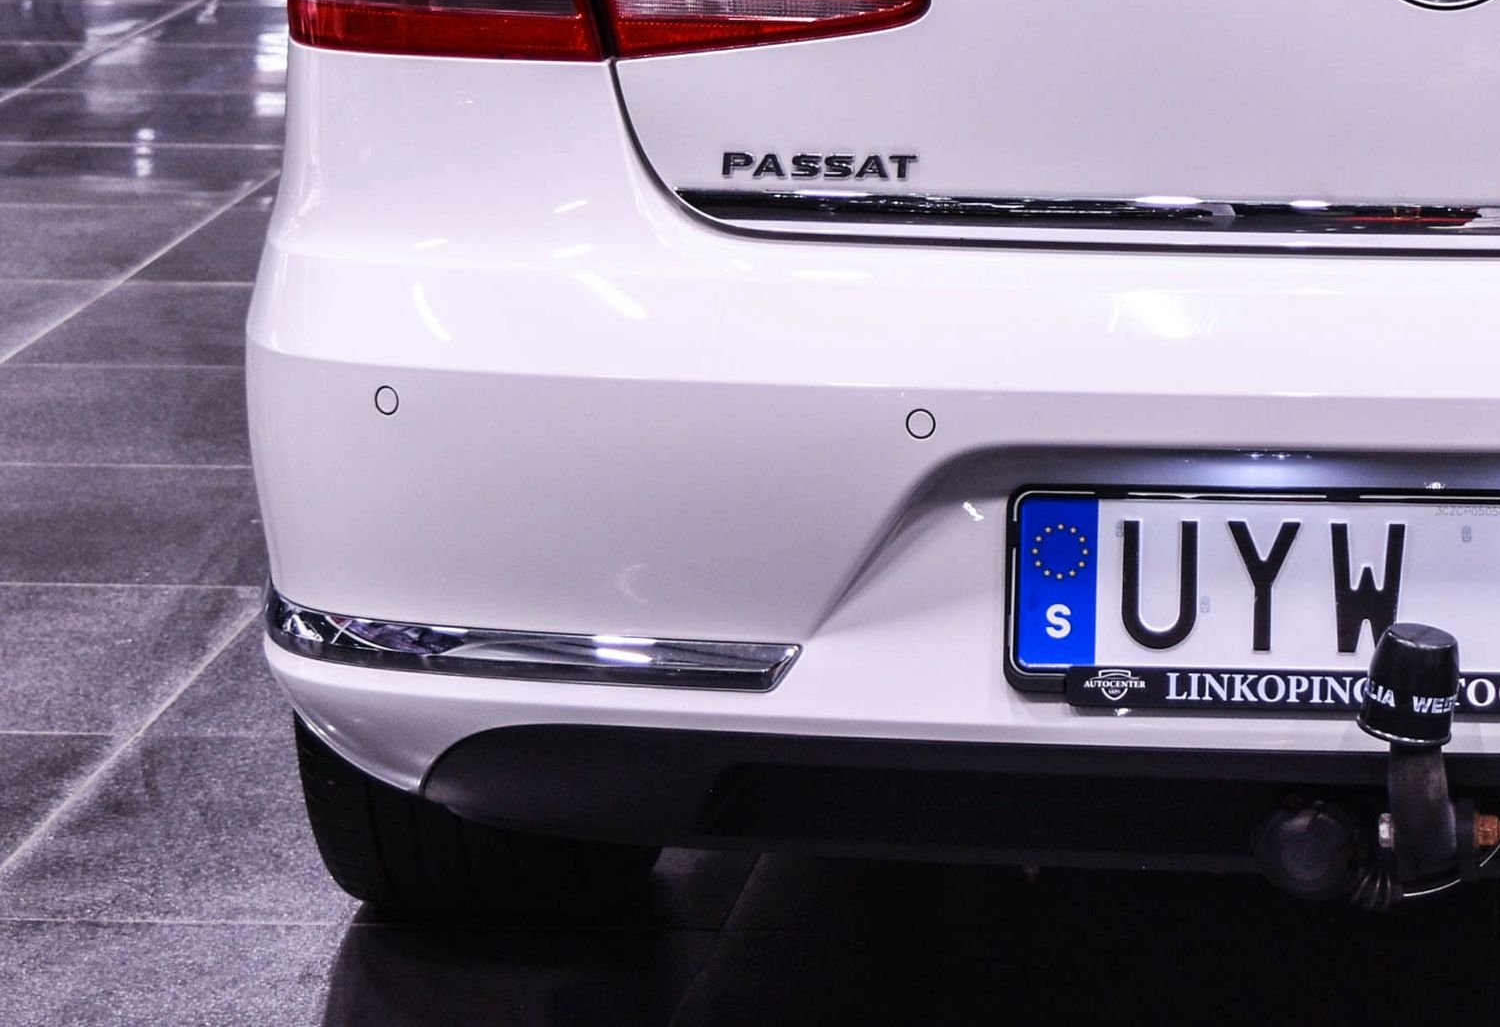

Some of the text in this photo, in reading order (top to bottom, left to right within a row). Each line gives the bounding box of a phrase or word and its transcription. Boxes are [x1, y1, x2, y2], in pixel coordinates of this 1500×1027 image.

[721, 152, 918, 181] PASSAT
[1121, 519, 1407, 654] UYW
[1045, 603, 1072, 639] S
[1083, 680, 1146, 688] AUTOCENTER
